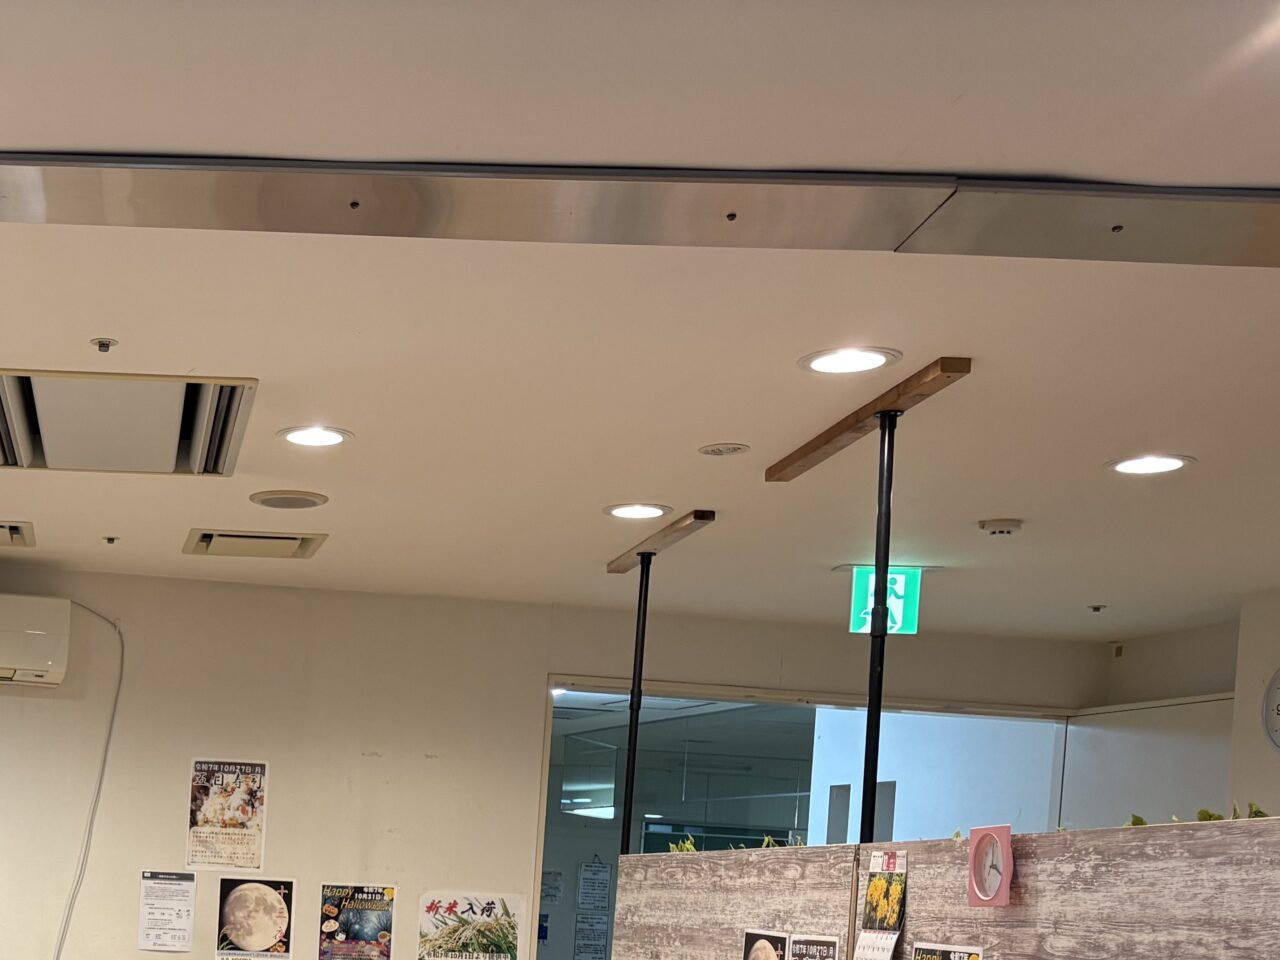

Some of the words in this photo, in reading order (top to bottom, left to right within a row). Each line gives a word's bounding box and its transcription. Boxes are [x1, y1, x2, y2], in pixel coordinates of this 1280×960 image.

[322, 886, 355, 898] Happy
[425, 899, 497, 918] 新米入荷
